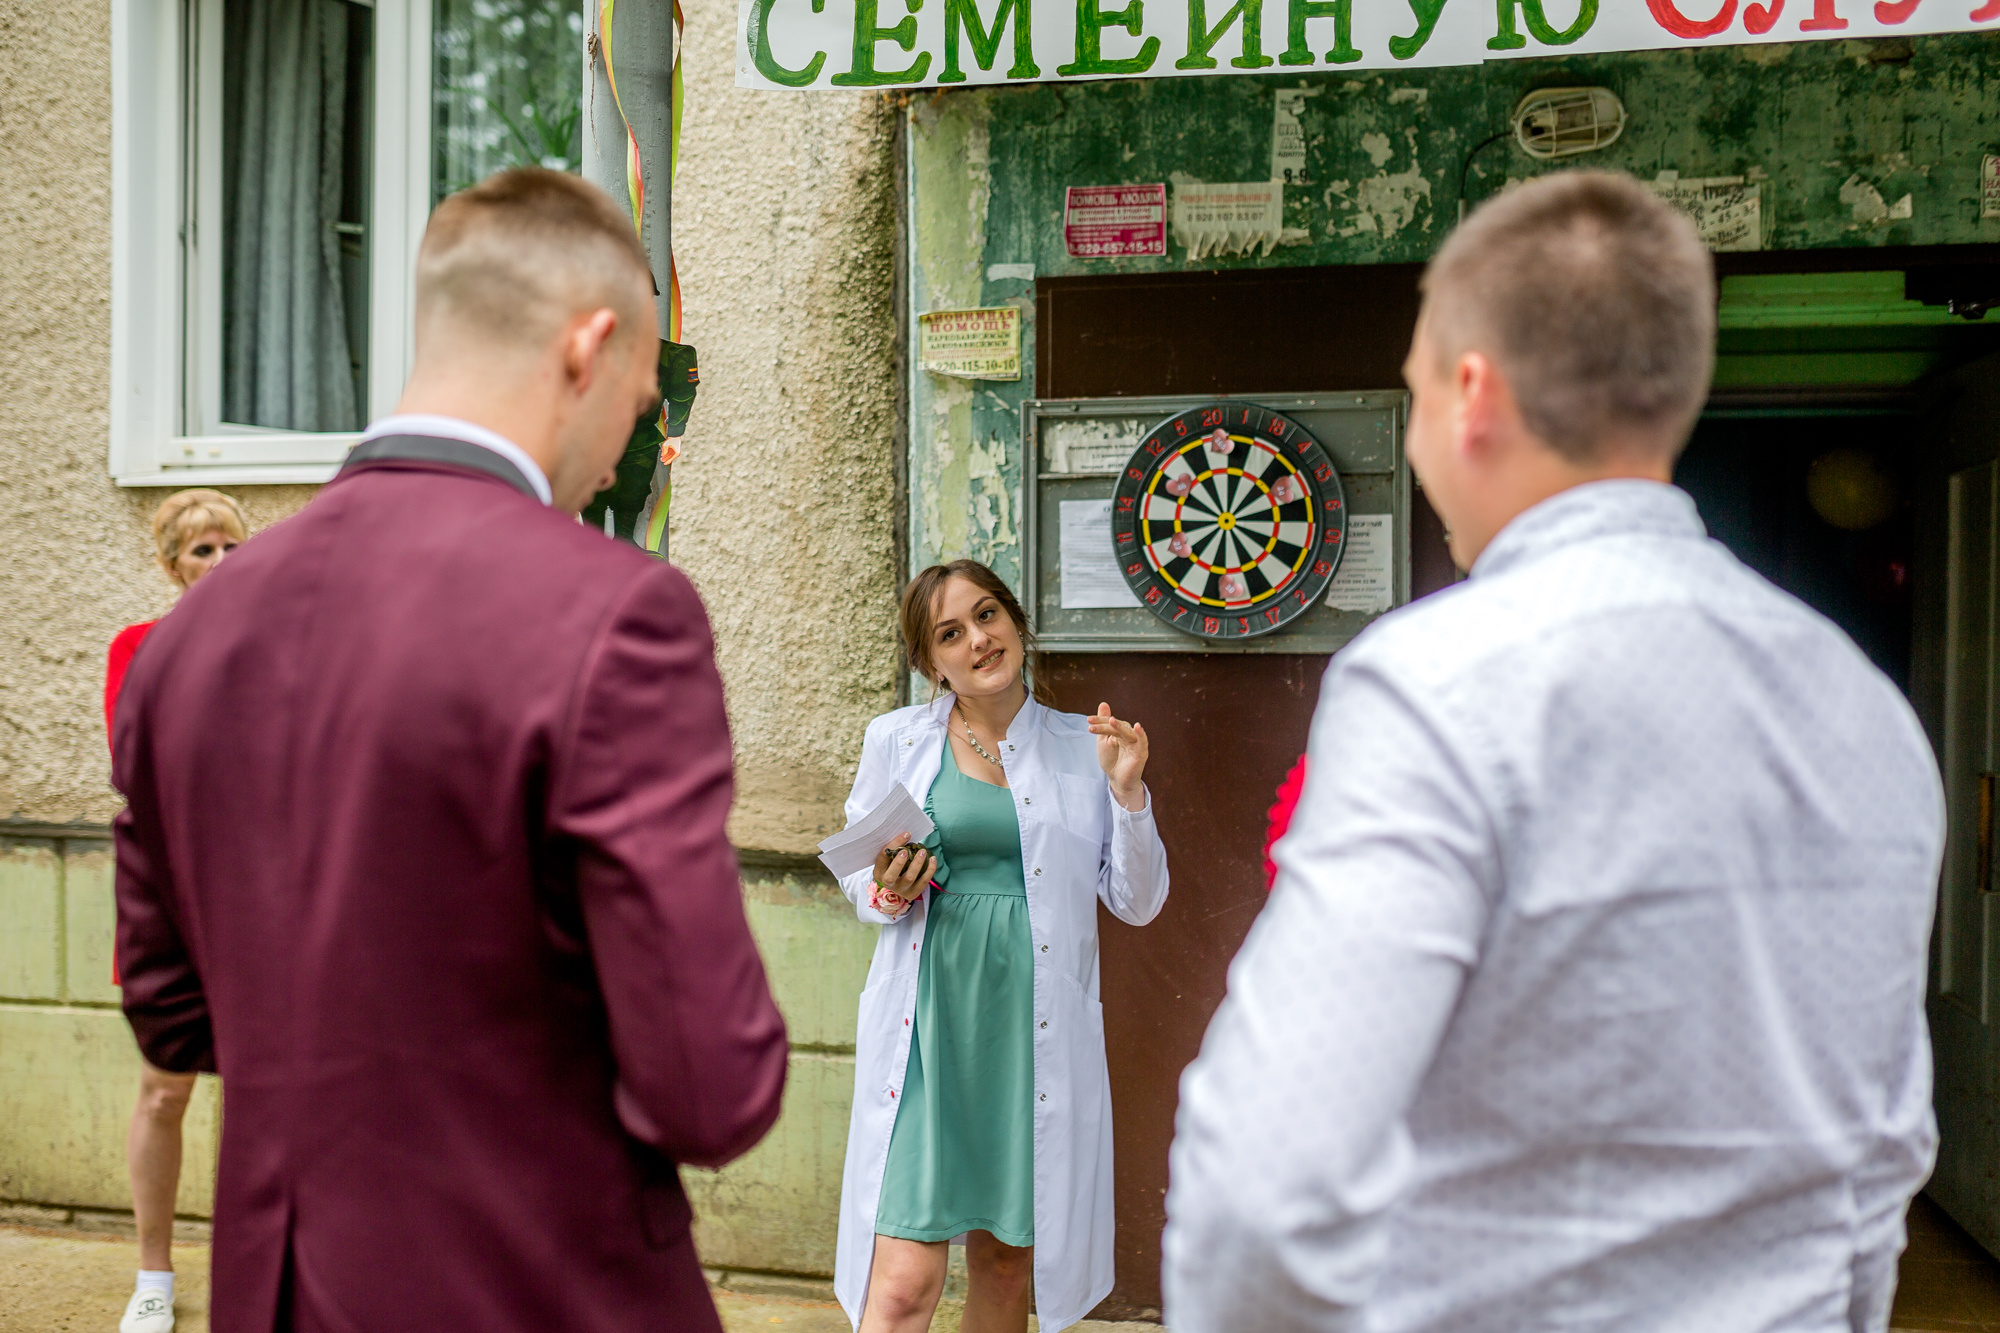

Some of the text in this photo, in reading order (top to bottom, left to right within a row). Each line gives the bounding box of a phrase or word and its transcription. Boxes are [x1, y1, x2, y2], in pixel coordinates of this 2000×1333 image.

[1120, 192, 1161, 205] ЛЮДЯМ
[925, 310, 1015, 323] АНОНИМНАЯ
[1202, 409, 1223, 427] 20
[1241, 409, 1248, 425] 1
[1174, 420, 1187, 436] 5
[1268, 418, 1285, 436] 18
[1145, 438, 1165, 457] 12
[1297, 441, 1312, 454] 4
[1128, 468, 1143, 481] 9
[1313, 463, 1332, 482] 13
[1117, 496, 1134, 512] 14
[1117, 531, 1134, 544] 11
[1325, 528, 1341, 544] 10
[1126, 562, 1143, 575] 8
[1313, 559, 1332, 578] 15
[1144, 585, 1163, 605] 16
[1293, 589, 1309, 606] 2
[1172, 606, 1187, 622] 7
[1265, 606, 1280, 625] 17
[1204, 616, 1219, 635] 19
[1238, 617, 1250, 635] 3
